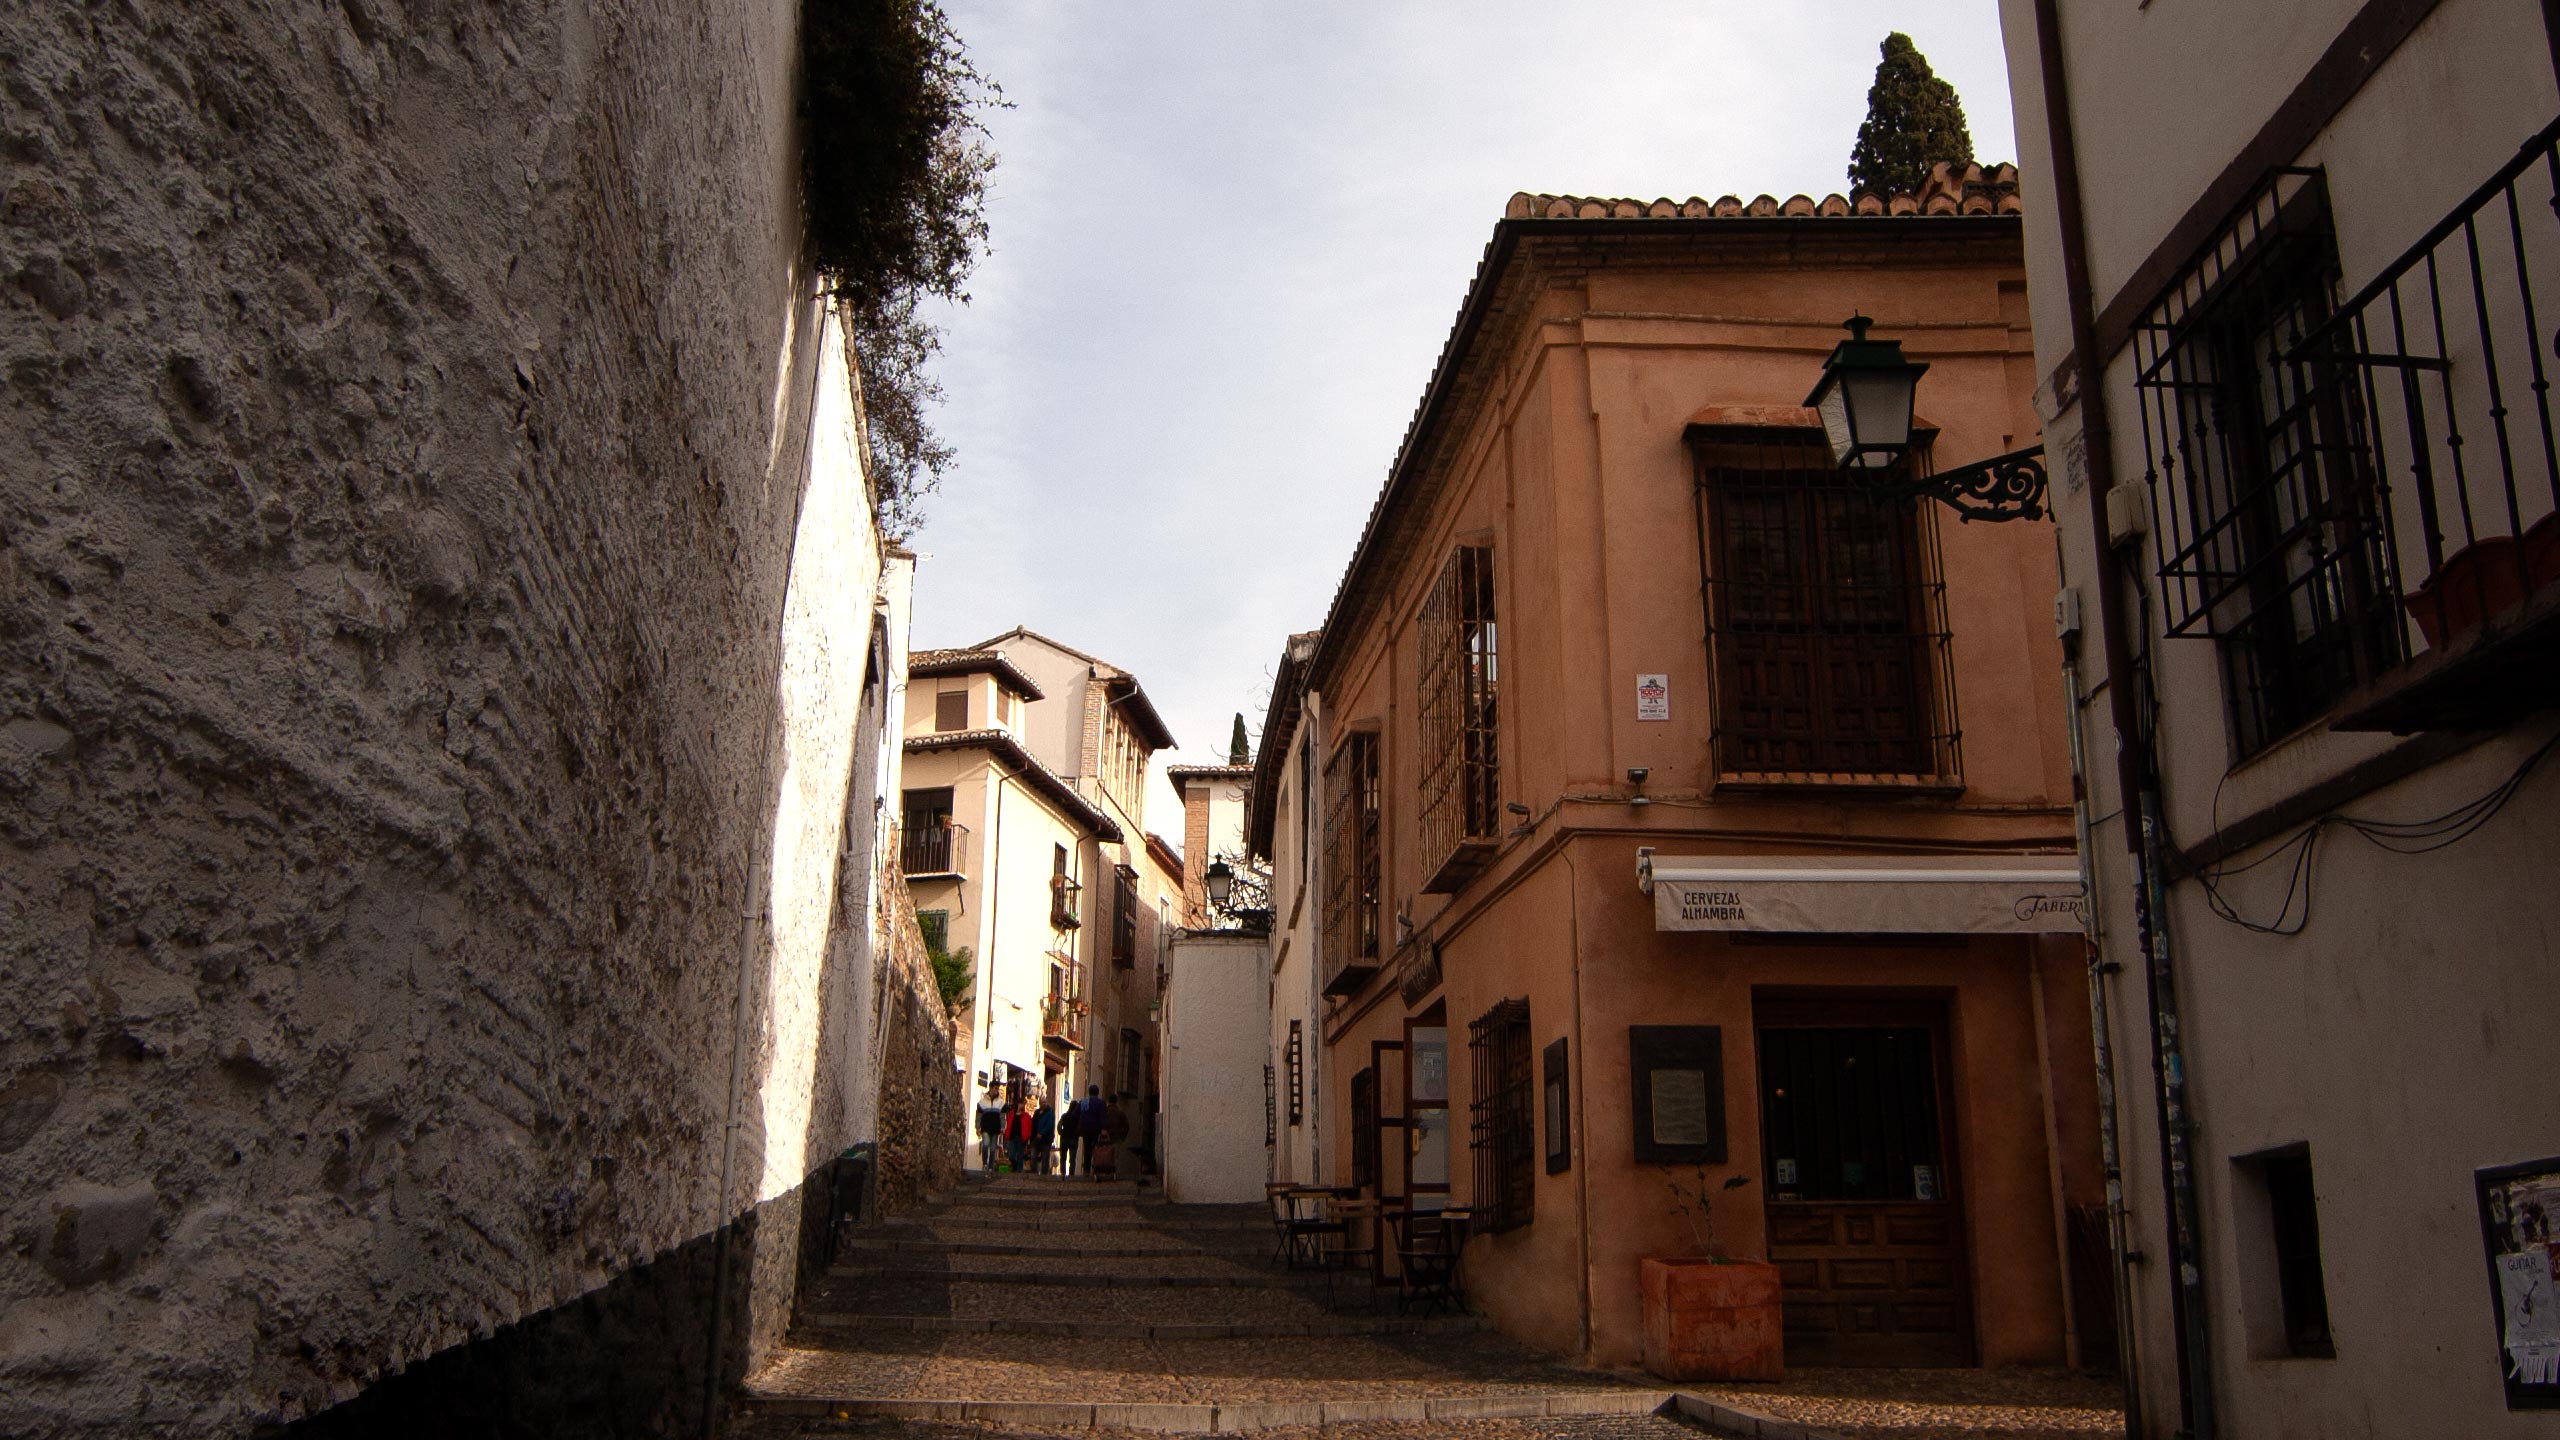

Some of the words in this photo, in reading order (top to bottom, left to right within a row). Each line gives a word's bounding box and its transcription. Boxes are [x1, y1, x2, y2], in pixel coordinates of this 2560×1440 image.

[1684, 892, 1741, 905] CERVEZAS
[1682, 907, 1745, 921] ALHAMBRA
[2507, 1256, 2537, 1271] GUITAR
